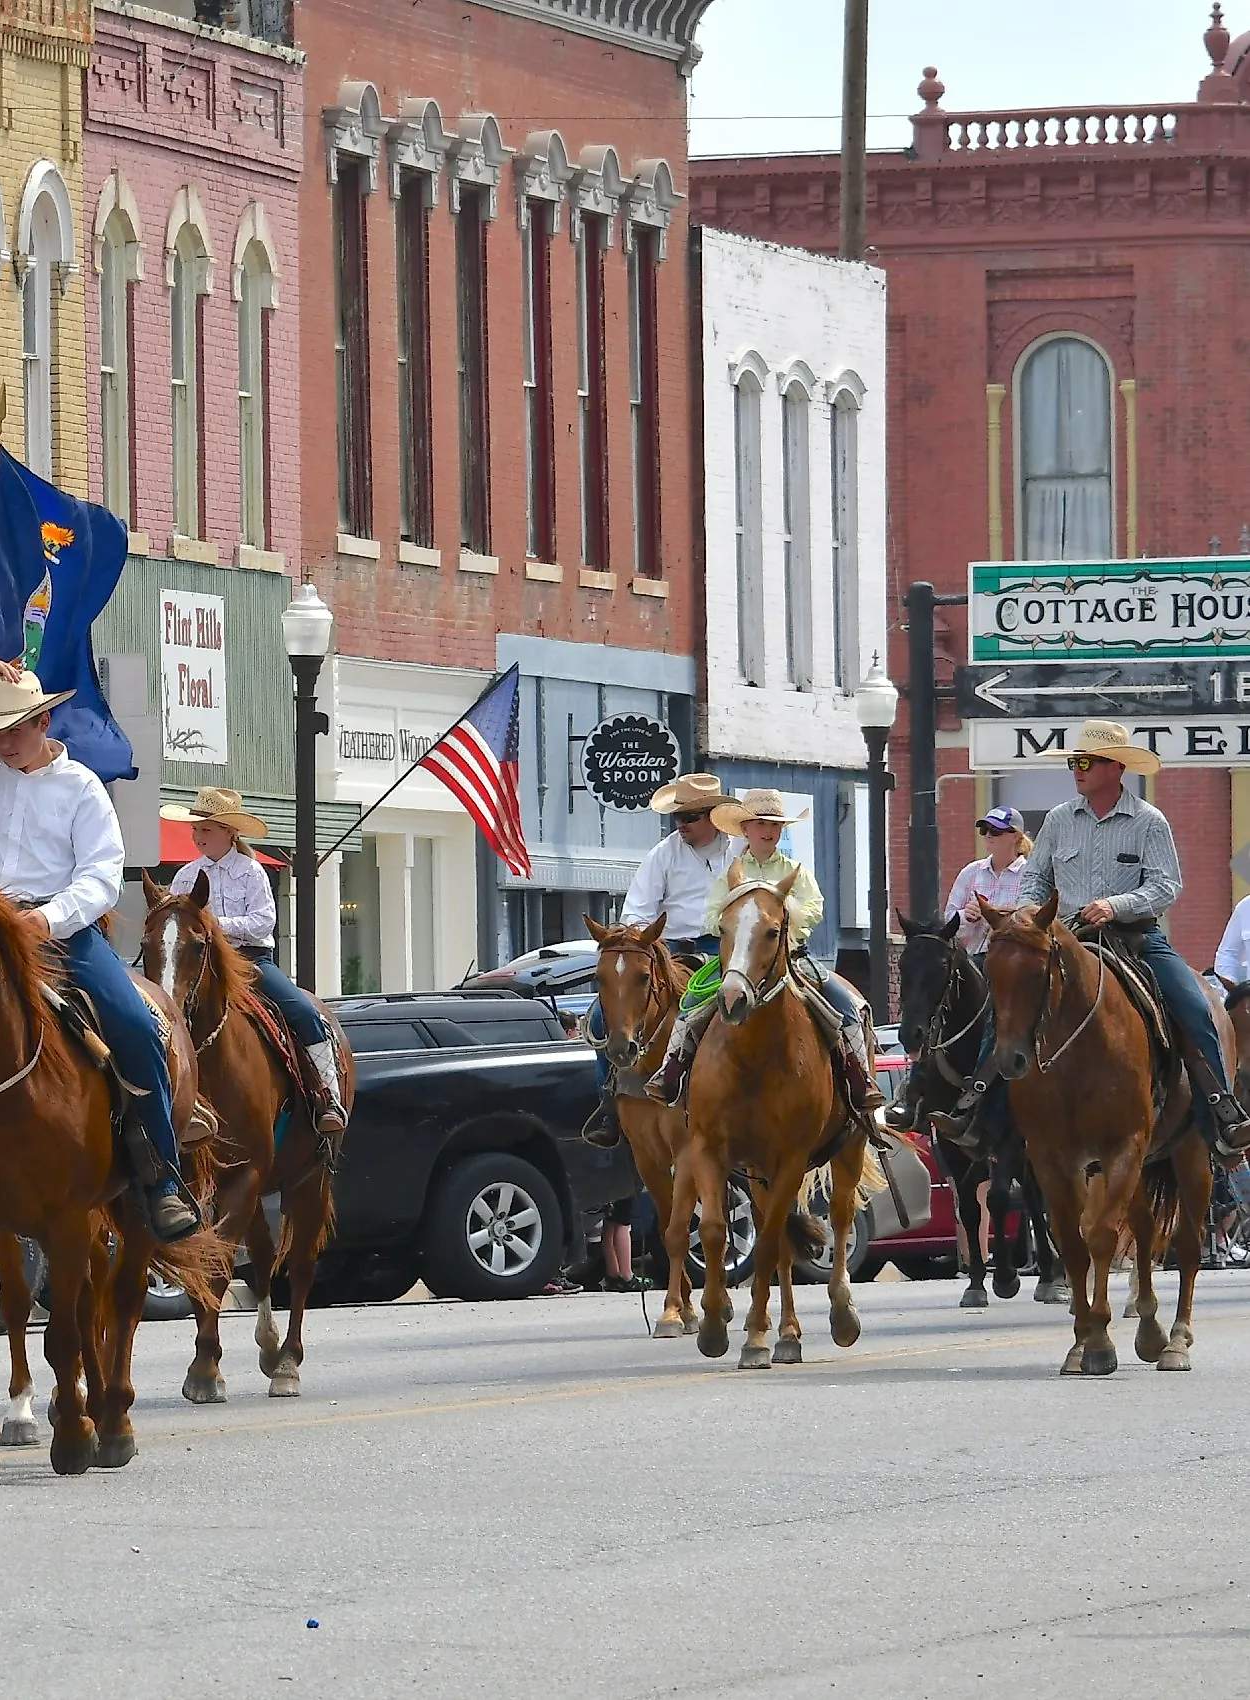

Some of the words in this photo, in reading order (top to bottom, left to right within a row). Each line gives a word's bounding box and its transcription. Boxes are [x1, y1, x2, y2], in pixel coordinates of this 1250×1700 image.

[1129, 586, 1158, 596] THE
[164, 601, 192, 648] Flint
[195, 607, 222, 650] Hills
[996, 597, 1157, 632] COTTAGE
[178, 663, 213, 708] Floral
[595, 751, 667, 769] Wooden
[603, 770, 661, 783] SPOON
